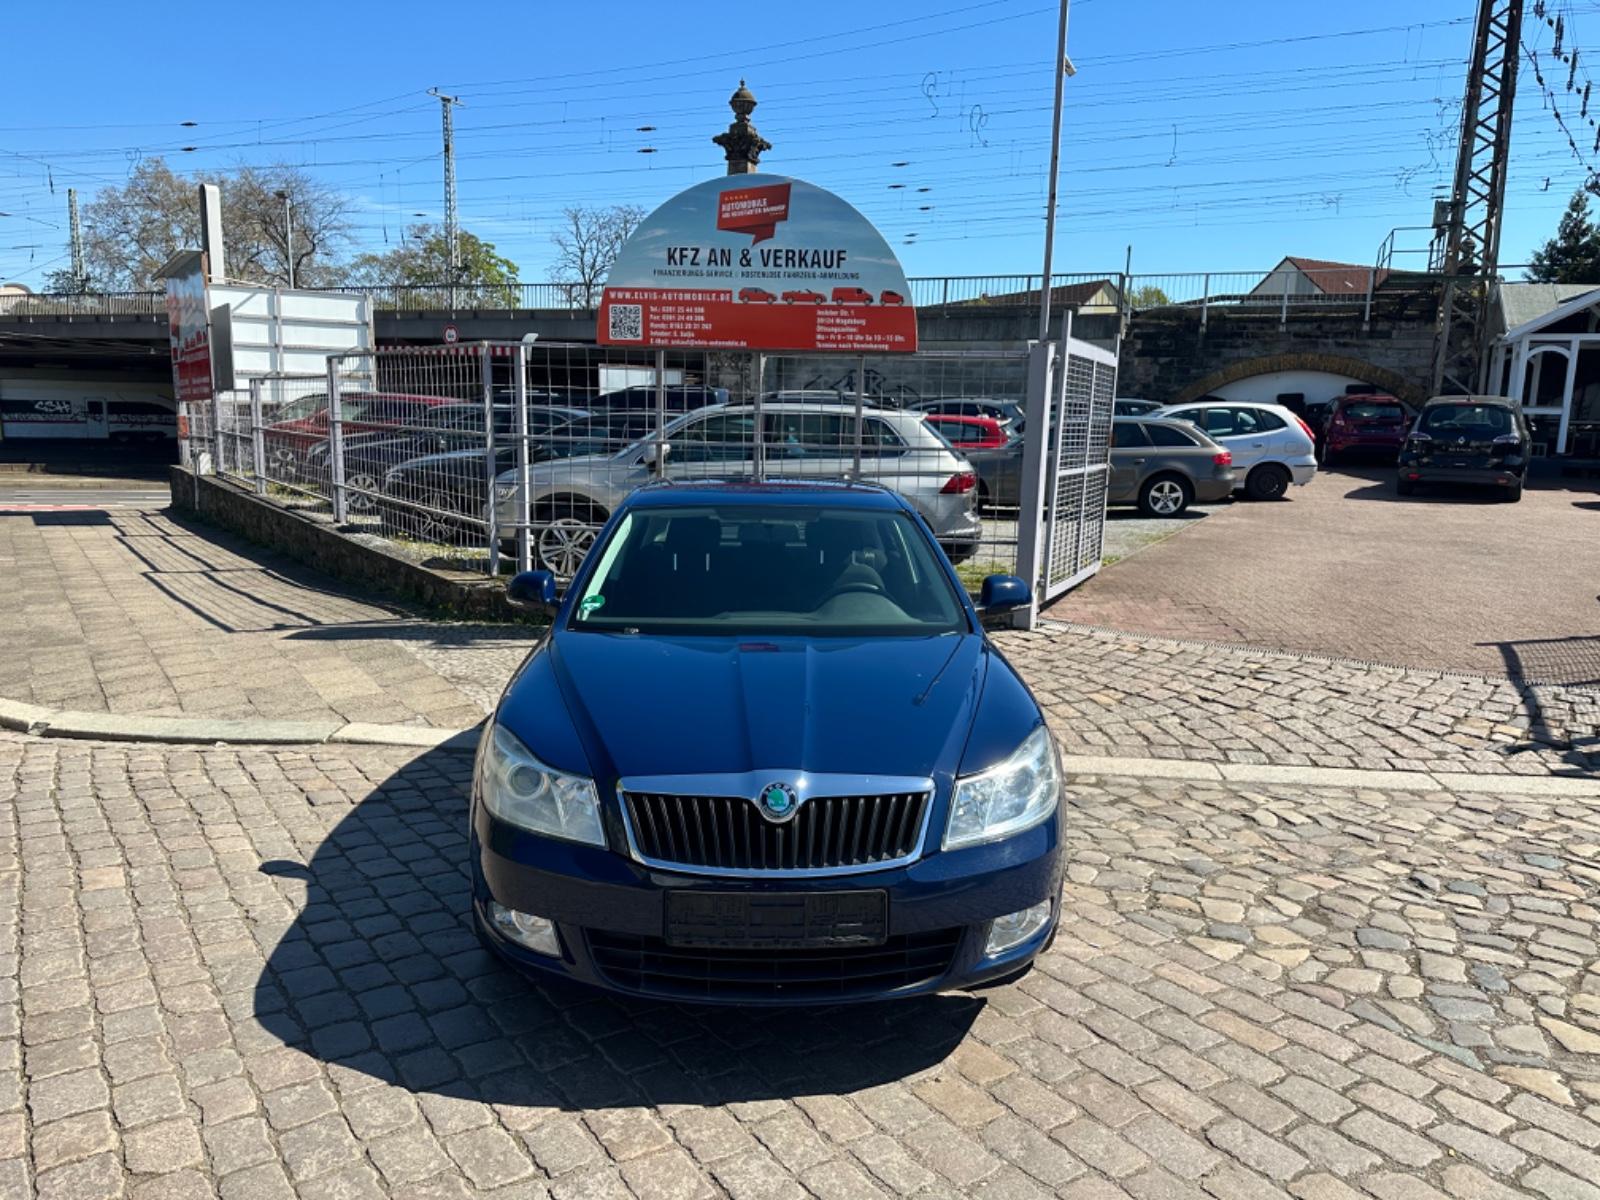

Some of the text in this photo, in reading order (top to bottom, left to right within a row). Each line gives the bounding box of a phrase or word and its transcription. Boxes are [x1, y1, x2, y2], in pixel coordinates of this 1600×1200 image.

[722, 198, 768, 212] AUTOMOBILE
[667, 247, 847, 269] KFZ AN & VERKAUF
[653, 268, 733, 278] FINANZIERUNGS-SERVICE
[741, 270, 782, 279] KOSTENLOSE
[608, 291, 730, 302] WWW.ELVIS-AUTOMOBILE.DE
